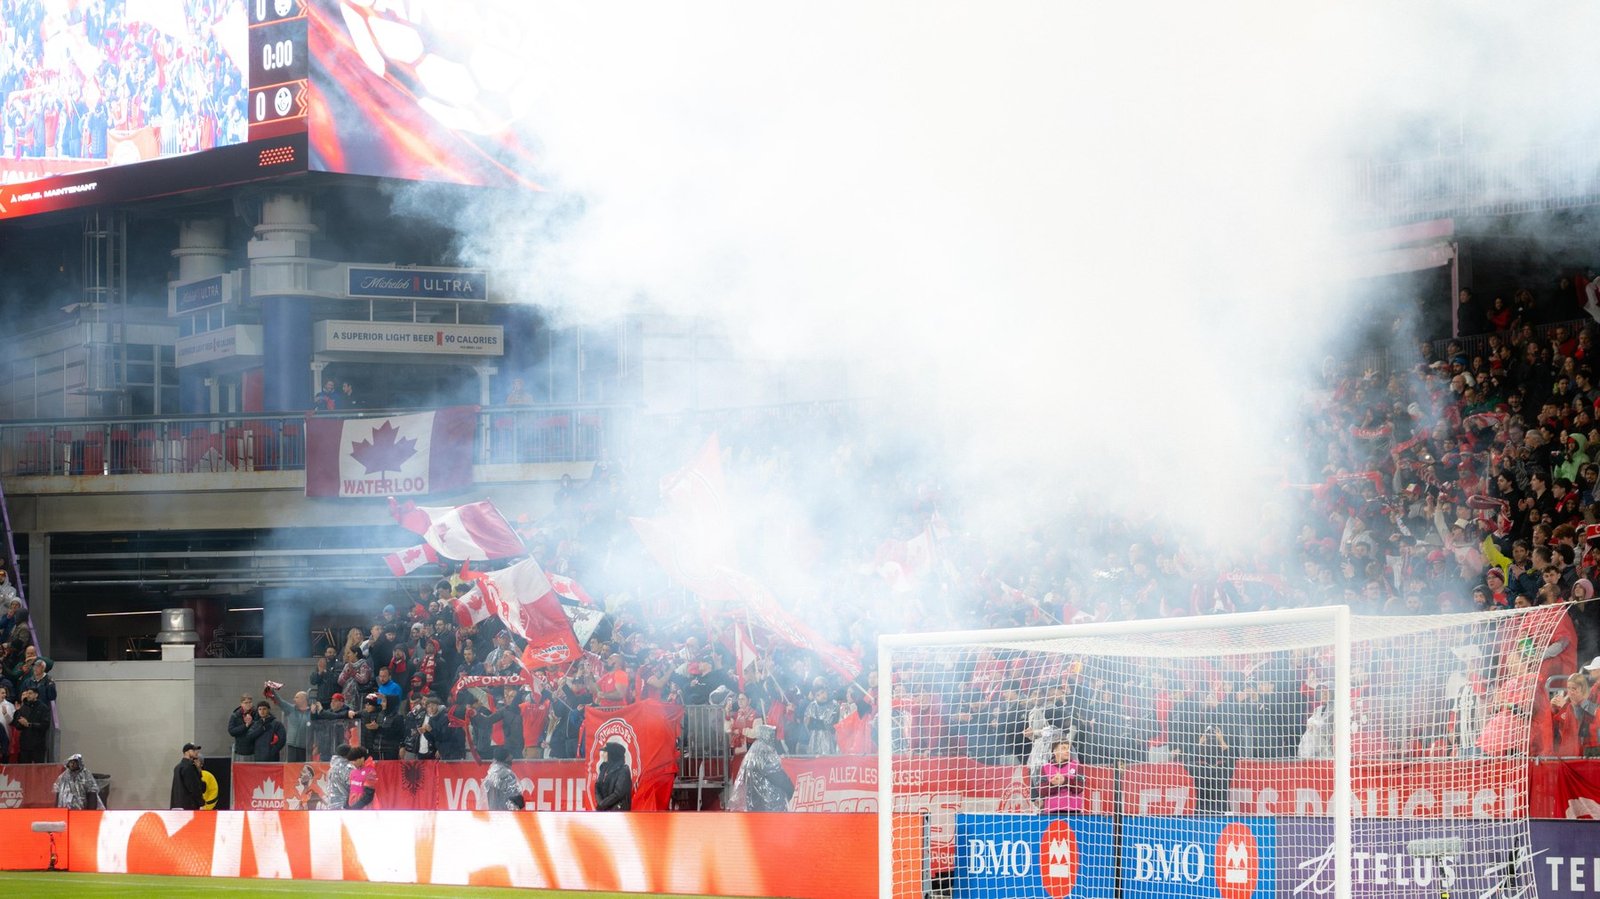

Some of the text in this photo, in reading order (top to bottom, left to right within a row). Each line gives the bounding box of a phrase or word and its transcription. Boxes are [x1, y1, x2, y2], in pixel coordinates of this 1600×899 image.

[263, 39, 293, 71] 0:00
[256, 91, 266, 122] 0
[44, 182, 98, 198] MAINTENANT
[361, 276, 473, 292] Michelob ULTRA
[333, 331, 497, 345] A SUPERIOR LIGHT BEER 90 CALORIES
[343, 477, 425, 494] WATERLOO
[598, 723, 632, 746] VOYAGEURS
[829, 766, 857, 784] ALLEZ
[859, 767, 878, 785] LES
[796, 772, 826, 804] The
[251, 800, 285, 809] CANADA
[968, 839, 1031, 876] BMO
[1134, 843, 1205, 883] BMO
[1354, 852, 1456, 888] TELUS
